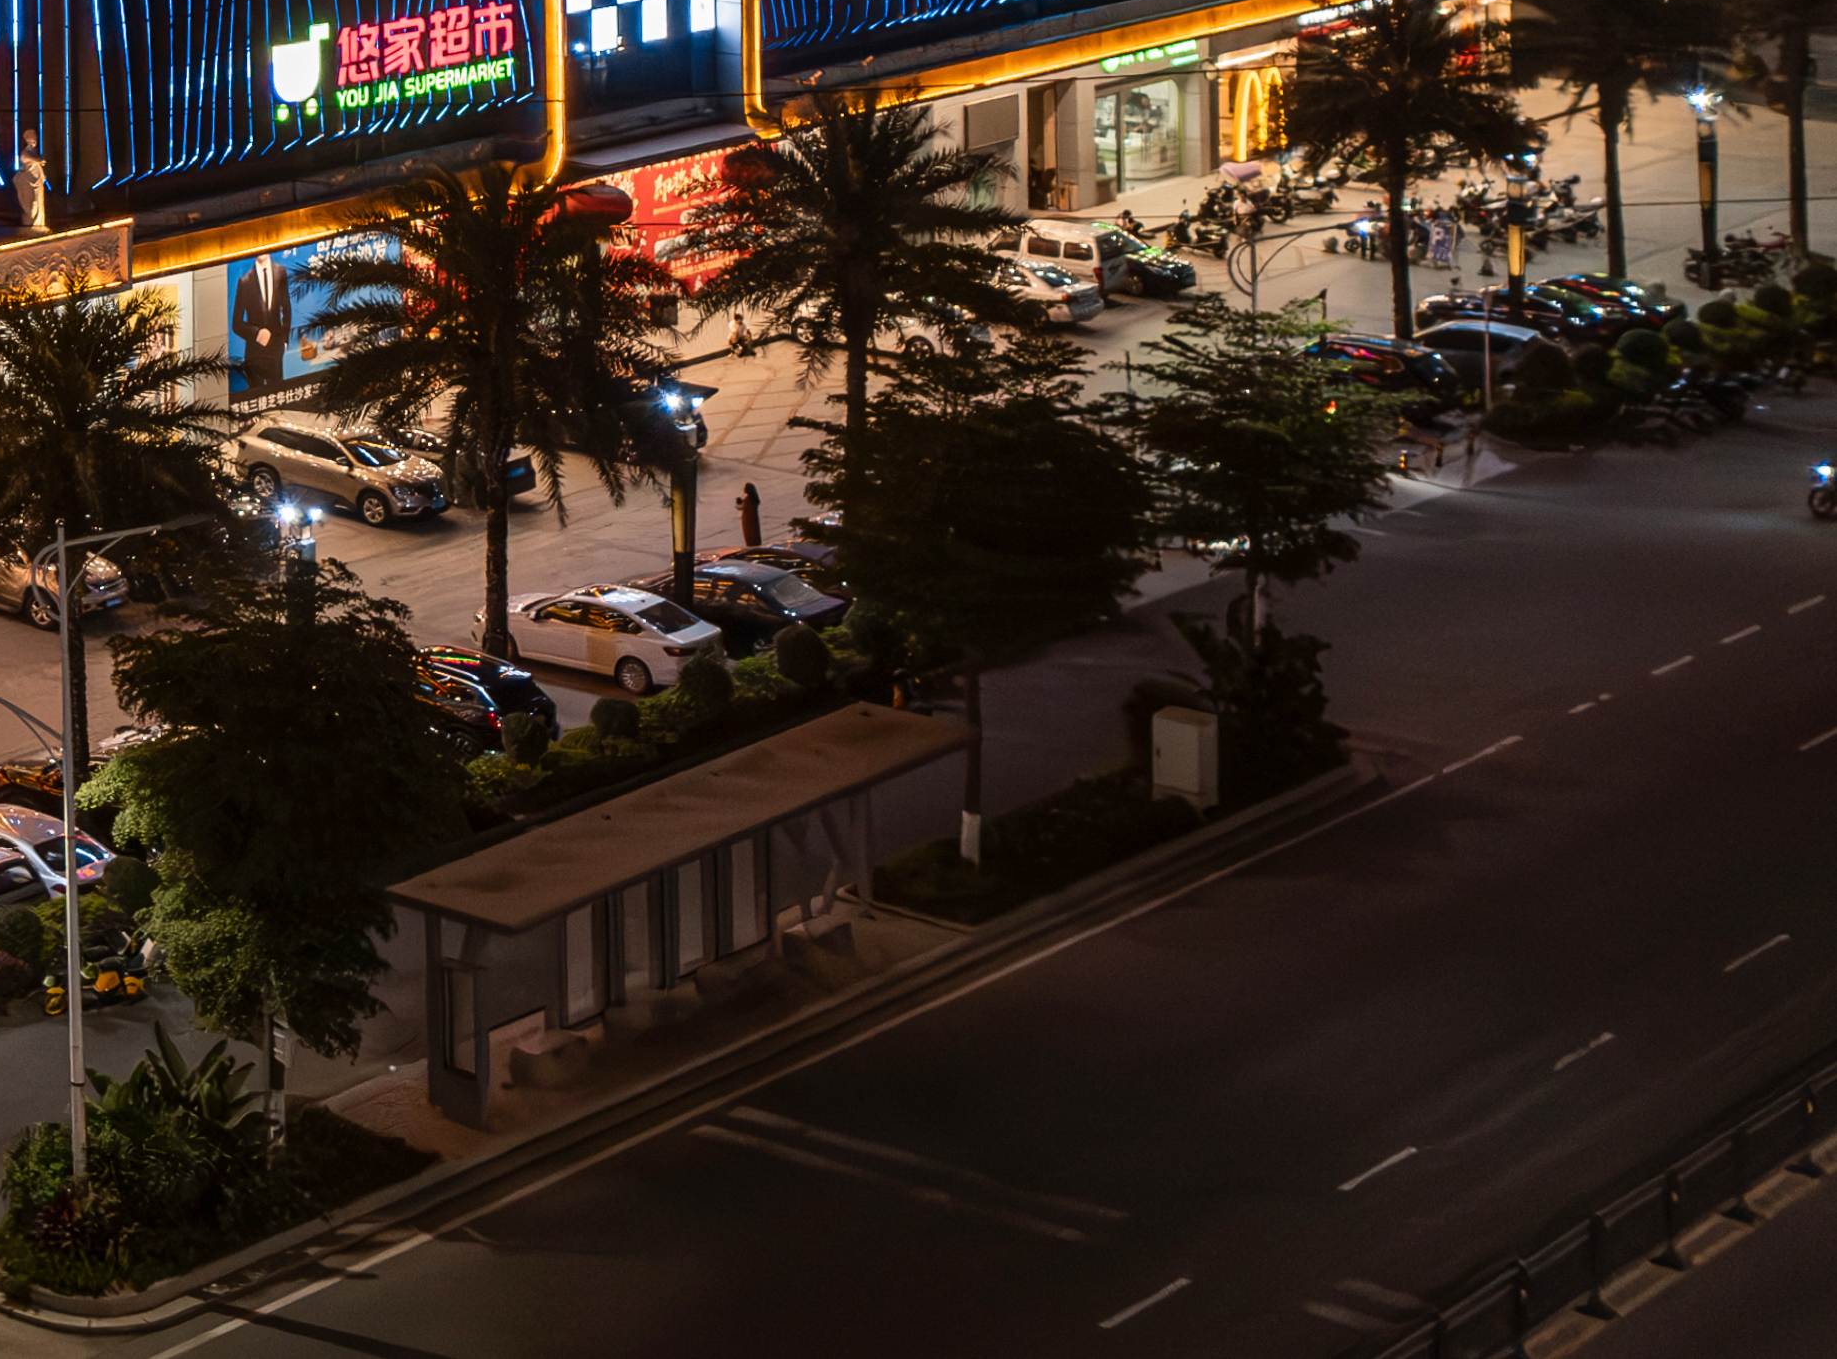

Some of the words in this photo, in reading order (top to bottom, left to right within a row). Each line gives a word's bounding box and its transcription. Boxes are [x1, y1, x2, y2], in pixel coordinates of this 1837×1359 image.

[336, 1, 514, 87] 悠家超市
[336, 88, 370, 109] YOU
[374, 83, 399, 104] JIA
[404, 57, 515, 98] SUPERMARKET
